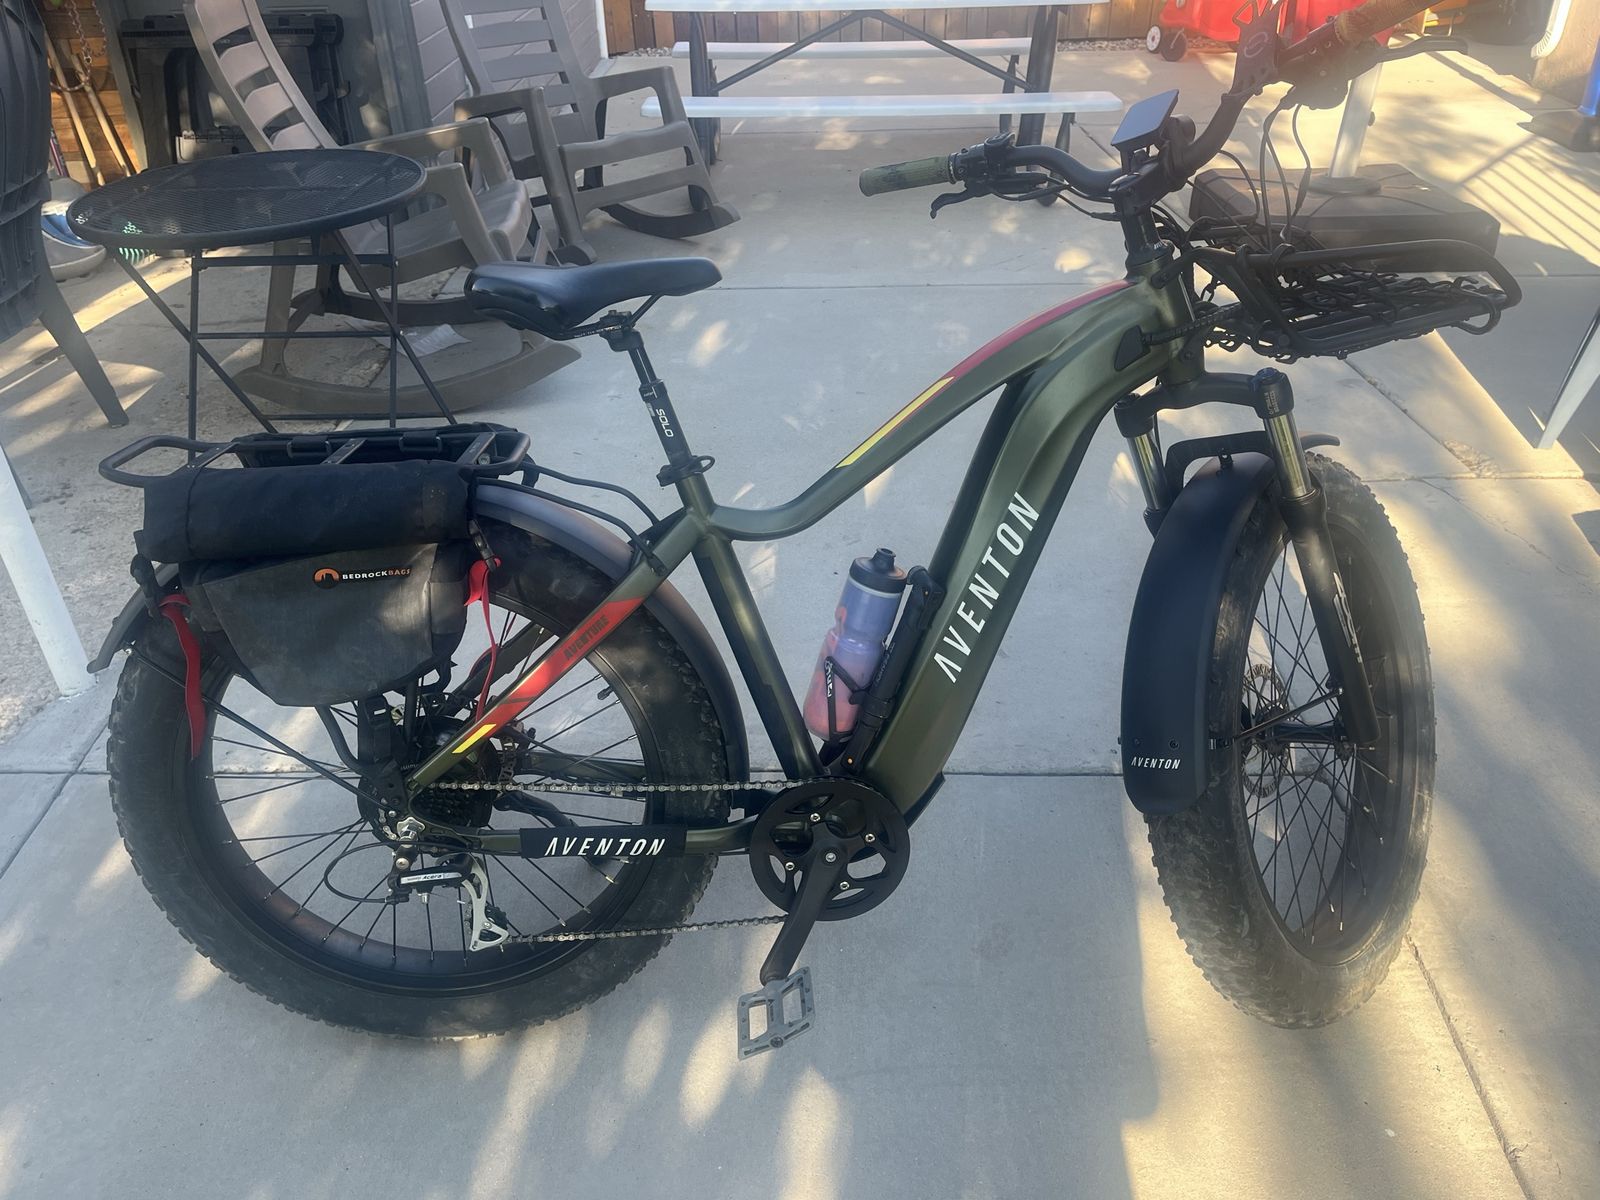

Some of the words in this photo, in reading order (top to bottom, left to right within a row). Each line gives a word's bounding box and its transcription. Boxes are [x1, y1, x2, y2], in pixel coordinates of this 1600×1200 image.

[655, 408, 674, 437] SOLO
[342, 568, 411, 580] BEDROCKBAGS
[933, 491, 1040, 684] AVENTON
[563, 614, 609, 659] AVENTURE
[1131, 756, 1181, 770] AVENTON
[544, 837, 666, 856] AVENTON
